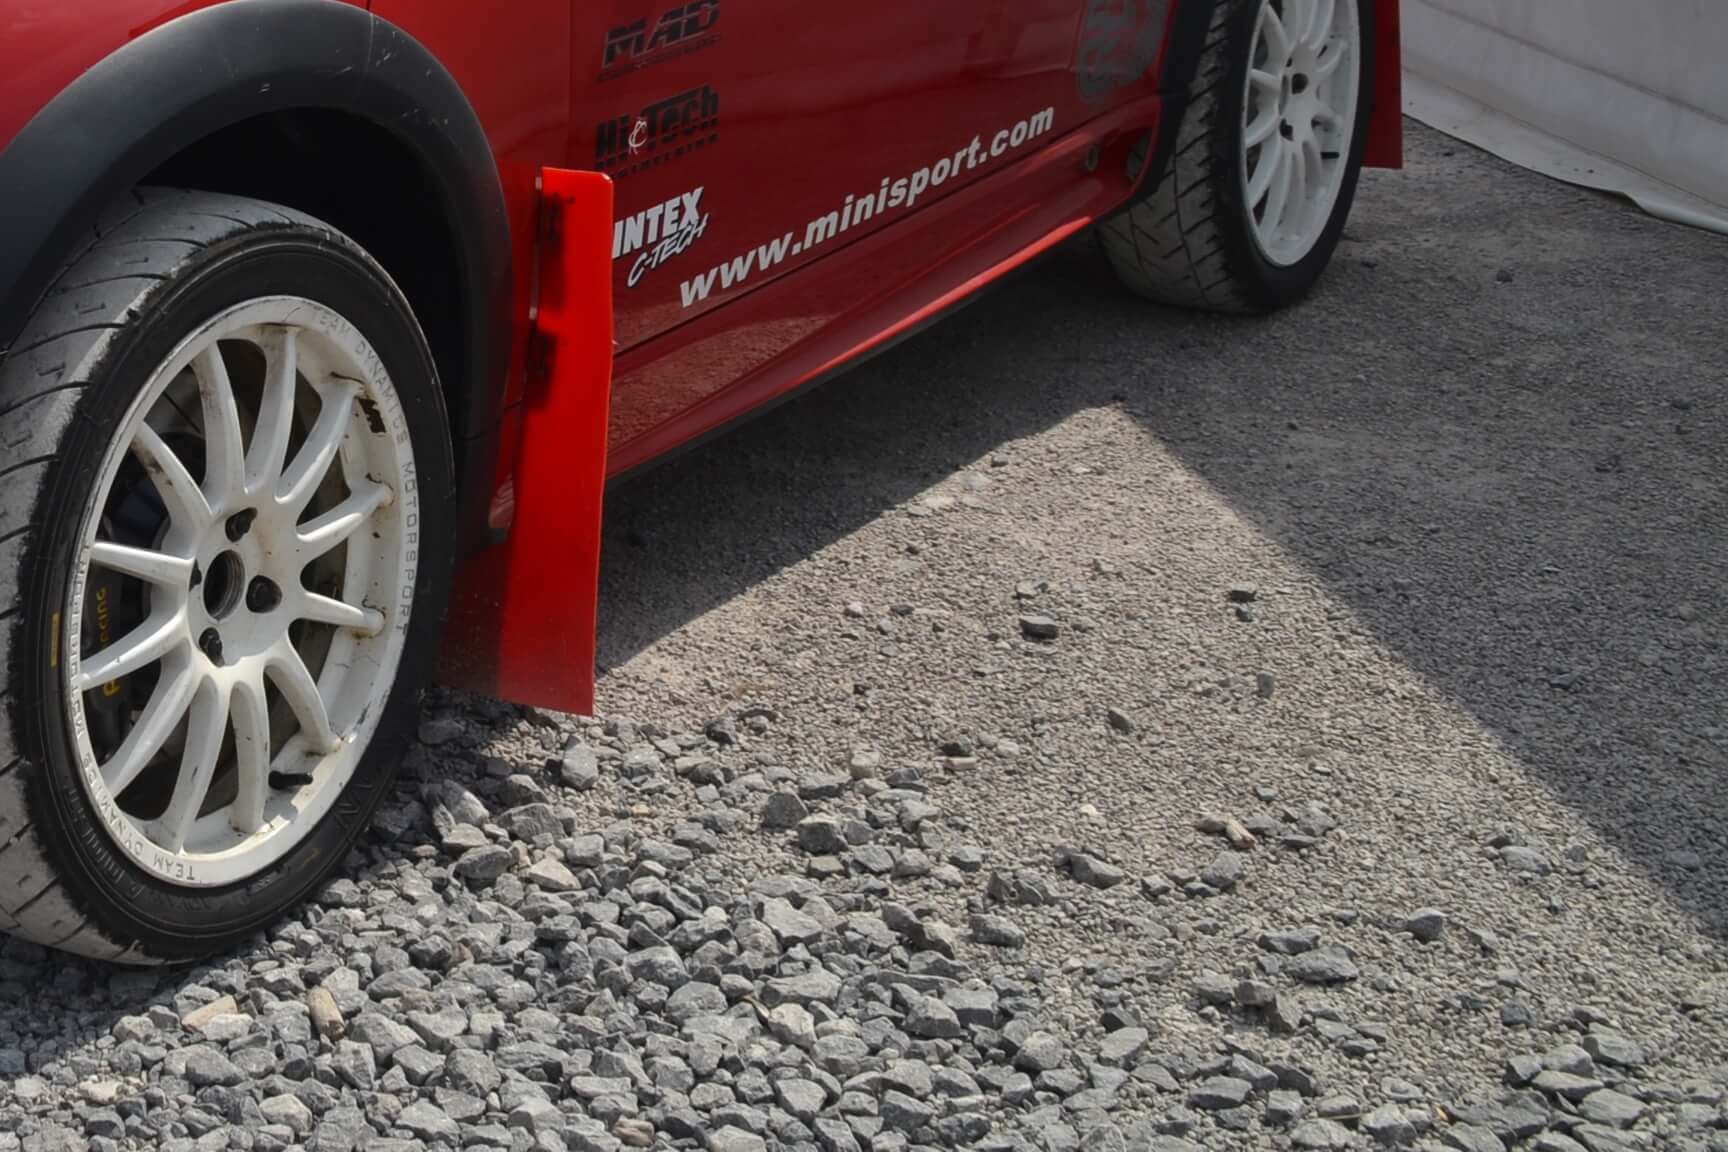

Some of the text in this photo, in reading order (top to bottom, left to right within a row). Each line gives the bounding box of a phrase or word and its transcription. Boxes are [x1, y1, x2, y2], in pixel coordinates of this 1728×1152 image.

[680, 106, 1055, 308] www.minisport.com
[394, 460, 418, 638] MOTORSPORT
[153, 853, 196, 882] TEAM
